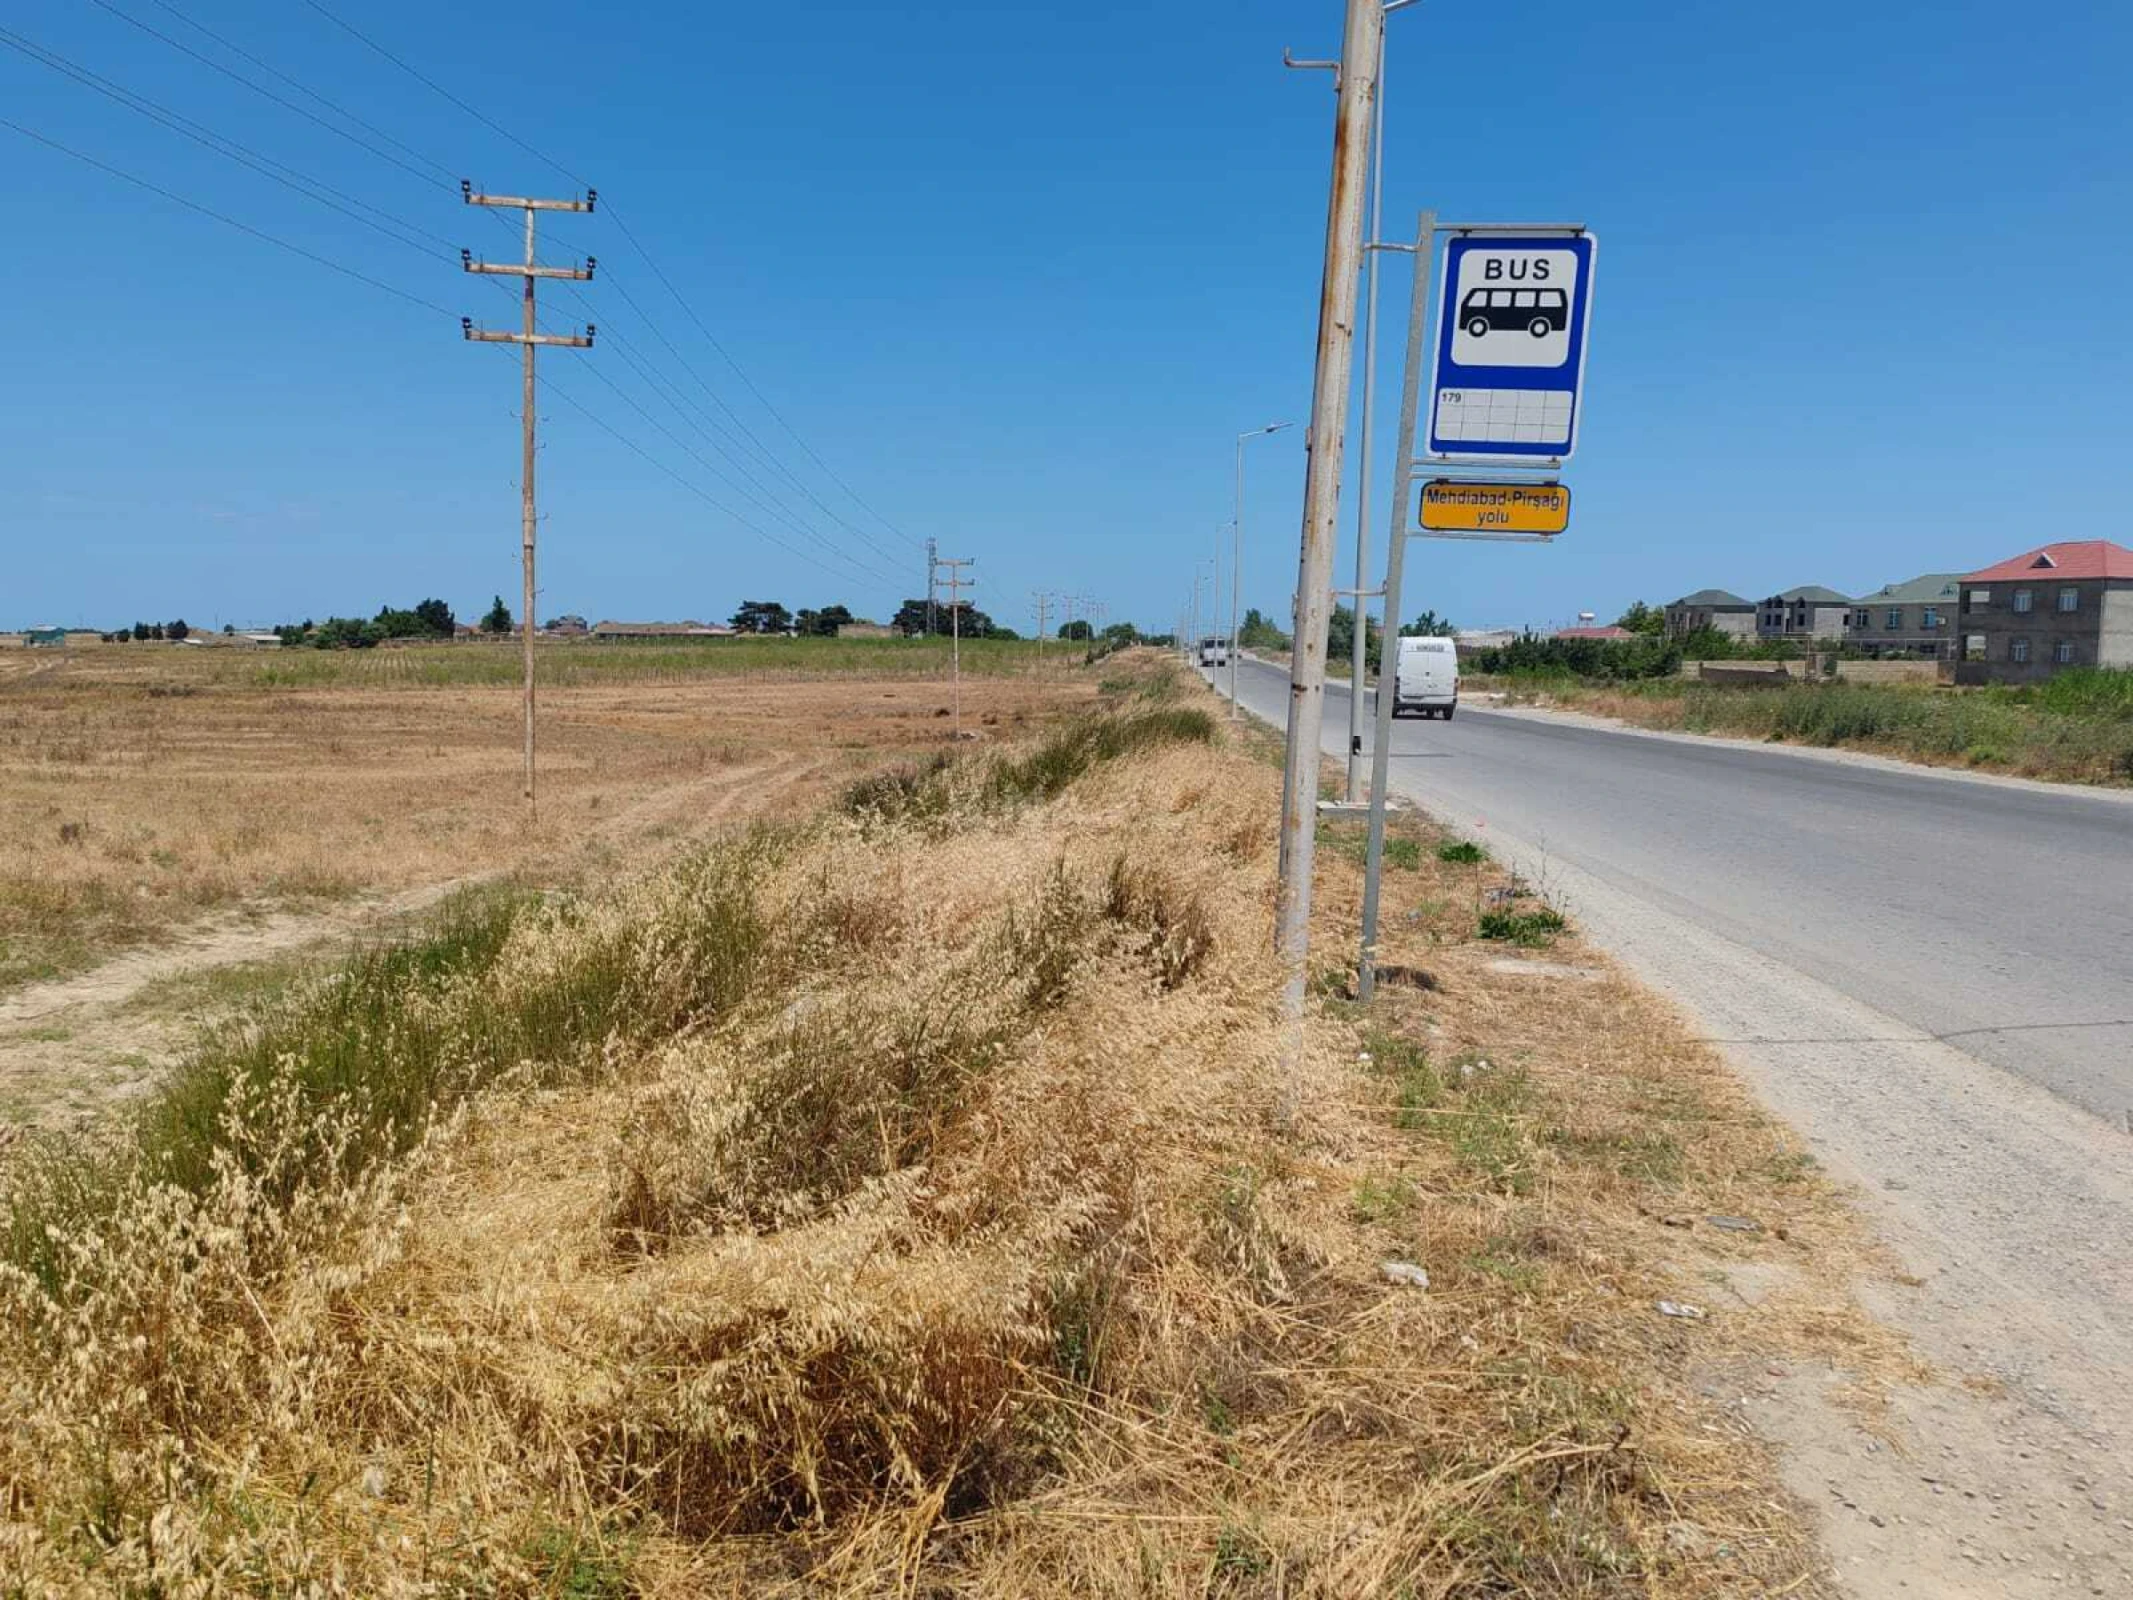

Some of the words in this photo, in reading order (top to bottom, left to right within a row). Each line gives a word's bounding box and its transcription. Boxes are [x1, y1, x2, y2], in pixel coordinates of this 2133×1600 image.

[1484, 258, 1550, 281] BUS
[1442, 392, 1462, 403] 179
[1476, 510, 1509, 526] yolu
